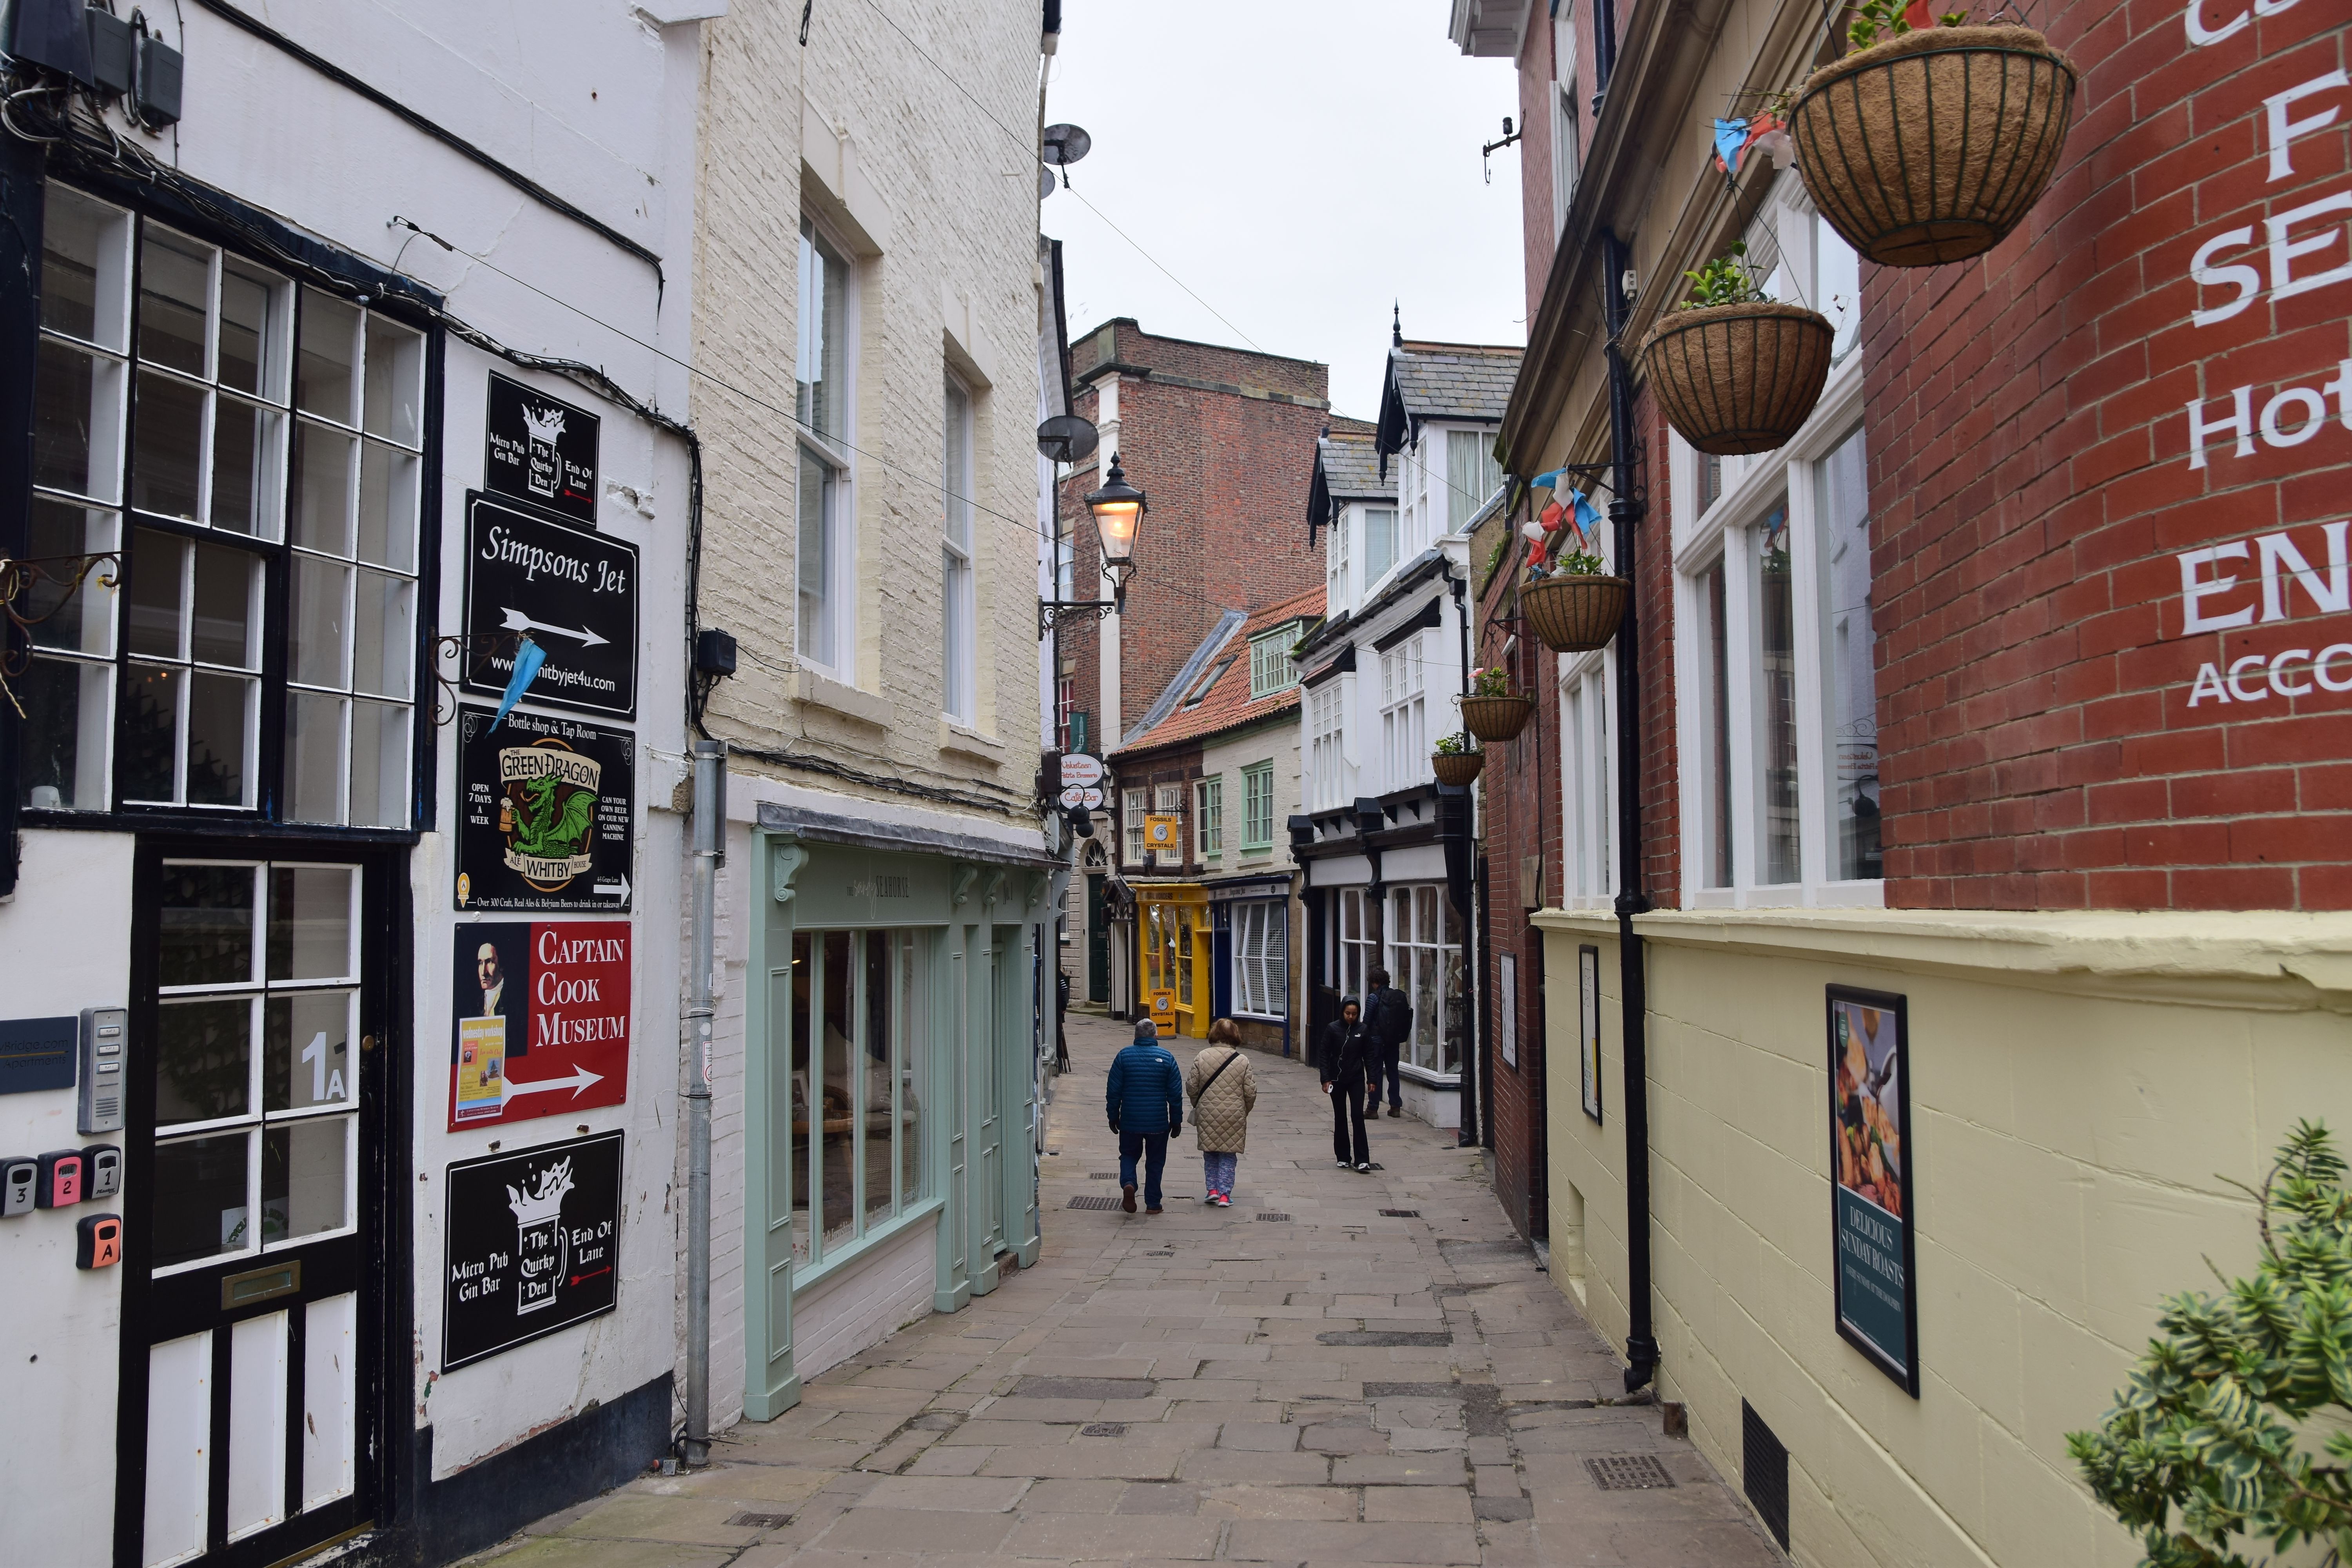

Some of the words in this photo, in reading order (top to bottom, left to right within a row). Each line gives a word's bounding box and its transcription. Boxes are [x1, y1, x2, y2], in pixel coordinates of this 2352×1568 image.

[2190, 190, 2352, 328] SE
[490, 432, 510, 449] Micro
[512, 441, 524, 454] Pub
[536, 444, 548, 458] The
[494, 448, 506, 461] Gin
[508, 452, 520, 466] Bar
[530, 457, 553, 475] Quirky
[565, 460, 580, 475] End
[582, 468, 592, 479] Of
[535, 474, 548, 487] Den
[570, 475, 587, 490] Lane
[482, 526, 589, 583] Simpsons
[593, 560, 626, 594] Jet
[2176, 521, 2352, 635] EN
[2187, 643, 2352, 707] ACCO
[508, 713, 531, 730] Bottle
[532, 718, 549, 735] shop
[551, 721, 558, 734] &
[561, 722, 575, 739] Tap
[576, 724, 597, 740] Room
[502, 755, 543, 777] GREEN
[544, 753, 599, 788] DRAGON
[472, 784, 489, 792] OPEN
[1065, 792, 1082, 802] Café
[1084, 792, 1098, 801] Bar
[469, 793, 474, 802] 7
[475, 794, 492, 804] DAYS
[470, 816, 489, 825] WEEK
[510, 857, 521, 867] ALE
[526, 860, 570, 878] WHITBY
[876, 876, 909, 898] SEAHORSE
[477, 897, 489, 907] Over
[490, 898, 499, 907] 300
[500, 897, 513, 908] Craft,
[514, 898, 524, 907] Real
[525, 898, 534, 907] Ales
[535, 898, 540, 907] &
[541, 898, 559, 909] Belgium
[561, 899, 573, 907] Beers
[579, 899, 591, 908] drink
[592, 900, 596, 908] in
[603, 900, 620, 909] takeaway
[539, 931, 625, 964] CAPTAIN
[537, 972, 600, 1005] COOK
[463, 1026, 485, 1040] wednesday
[485, 1025, 503, 1038] workshop
[536, 1012, 626, 1047] MUSEUM
[4, 1055, 67, 1070] Apartments
[105, 1171, 111, 1185] 1
[16, 1187, 27, 1203] 3
[63, 1181, 72, 1194] 2
[572, 1229, 592, 1246] End
[597, 1221, 612, 1238] Of
[1850, 1206, 1893, 1251] DELICIOUS
[530, 1232, 548, 1250] The
[102, 1244, 112, 1261] A
[579, 1246, 603, 1265] Lane
[1841, 1228, 1871, 1265] SUNDAY
[1872, 1248, 1904, 1289] ROASTS
[452, 1261, 484, 1283] Micro
[489, 1252, 508, 1272] Pub
[521, 1254, 554, 1278] Quirky
[459, 1283, 478, 1301] Gin
[482, 1277, 500, 1294] Bar
[527, 1282, 547, 1298] Den
